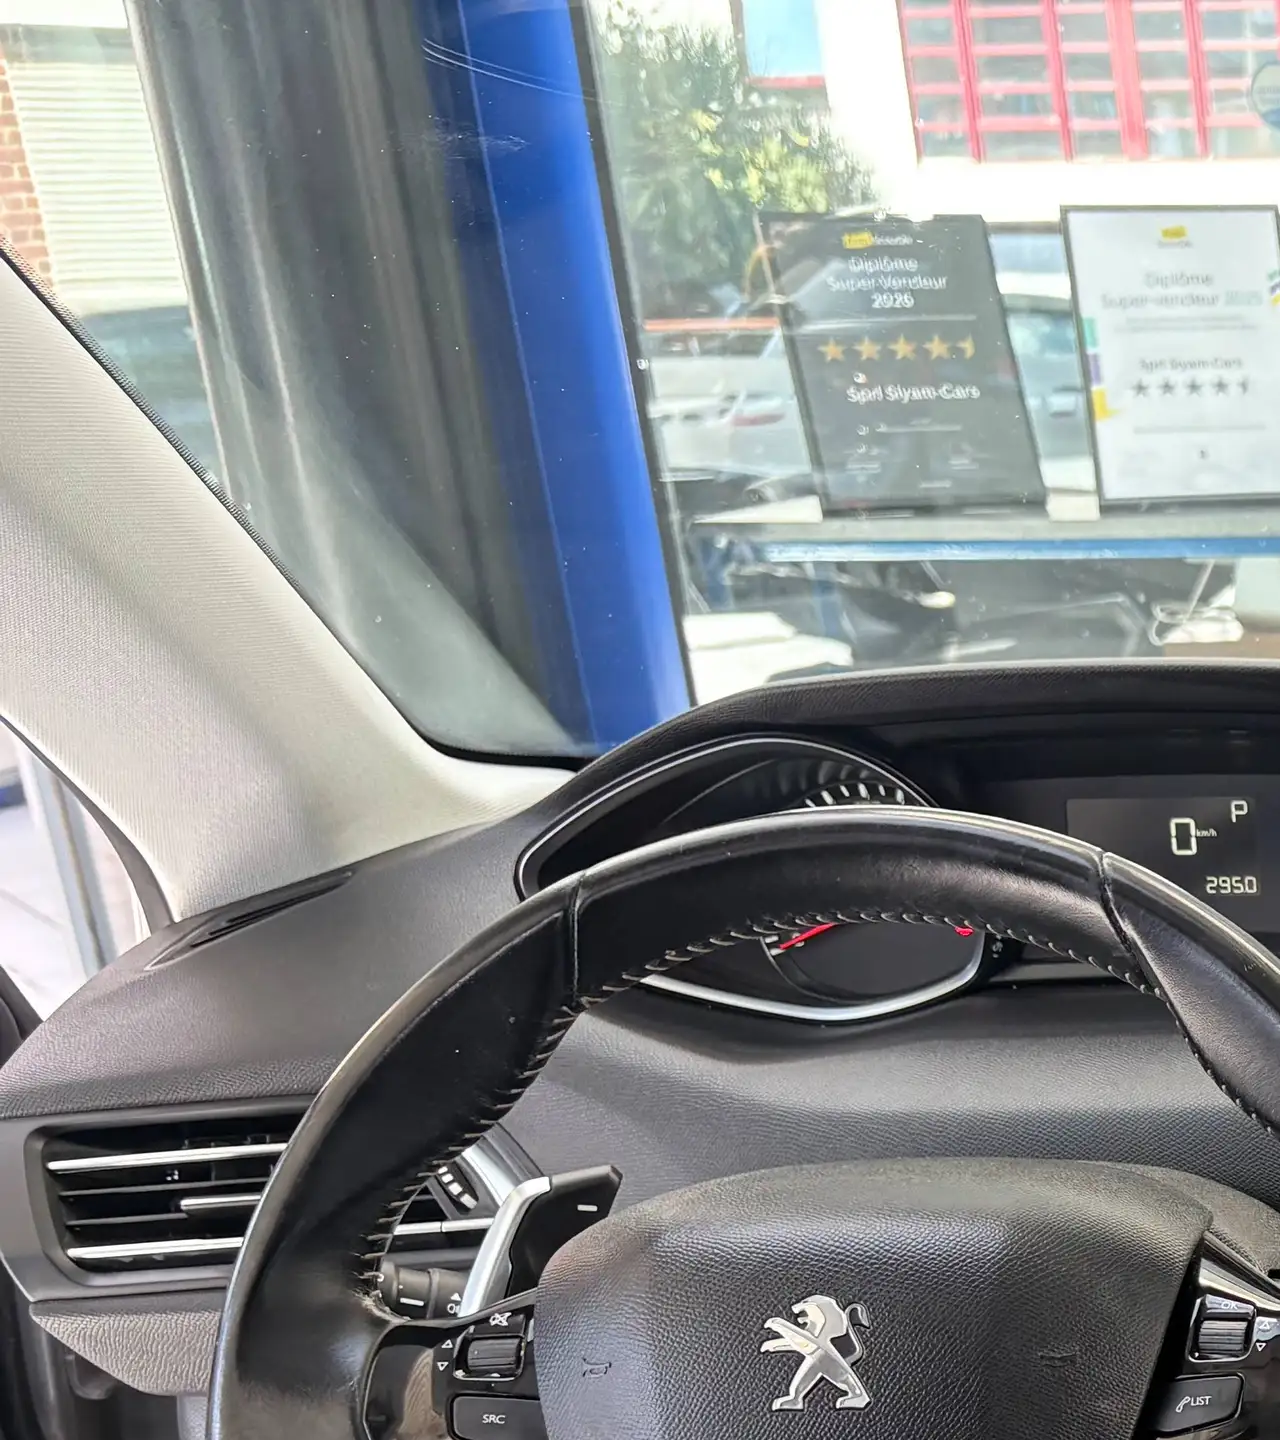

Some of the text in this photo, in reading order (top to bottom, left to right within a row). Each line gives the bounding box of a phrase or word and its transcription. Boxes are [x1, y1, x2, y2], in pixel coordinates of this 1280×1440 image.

[1231, 800, 1248, 822] P
[1170, 818, 1217, 855] 0 km/h
[1221, 1301, 1239, 1310] OK
[1190, 1395, 1212, 1406] LIST
[482, 1414, 506, 1424] SRC
